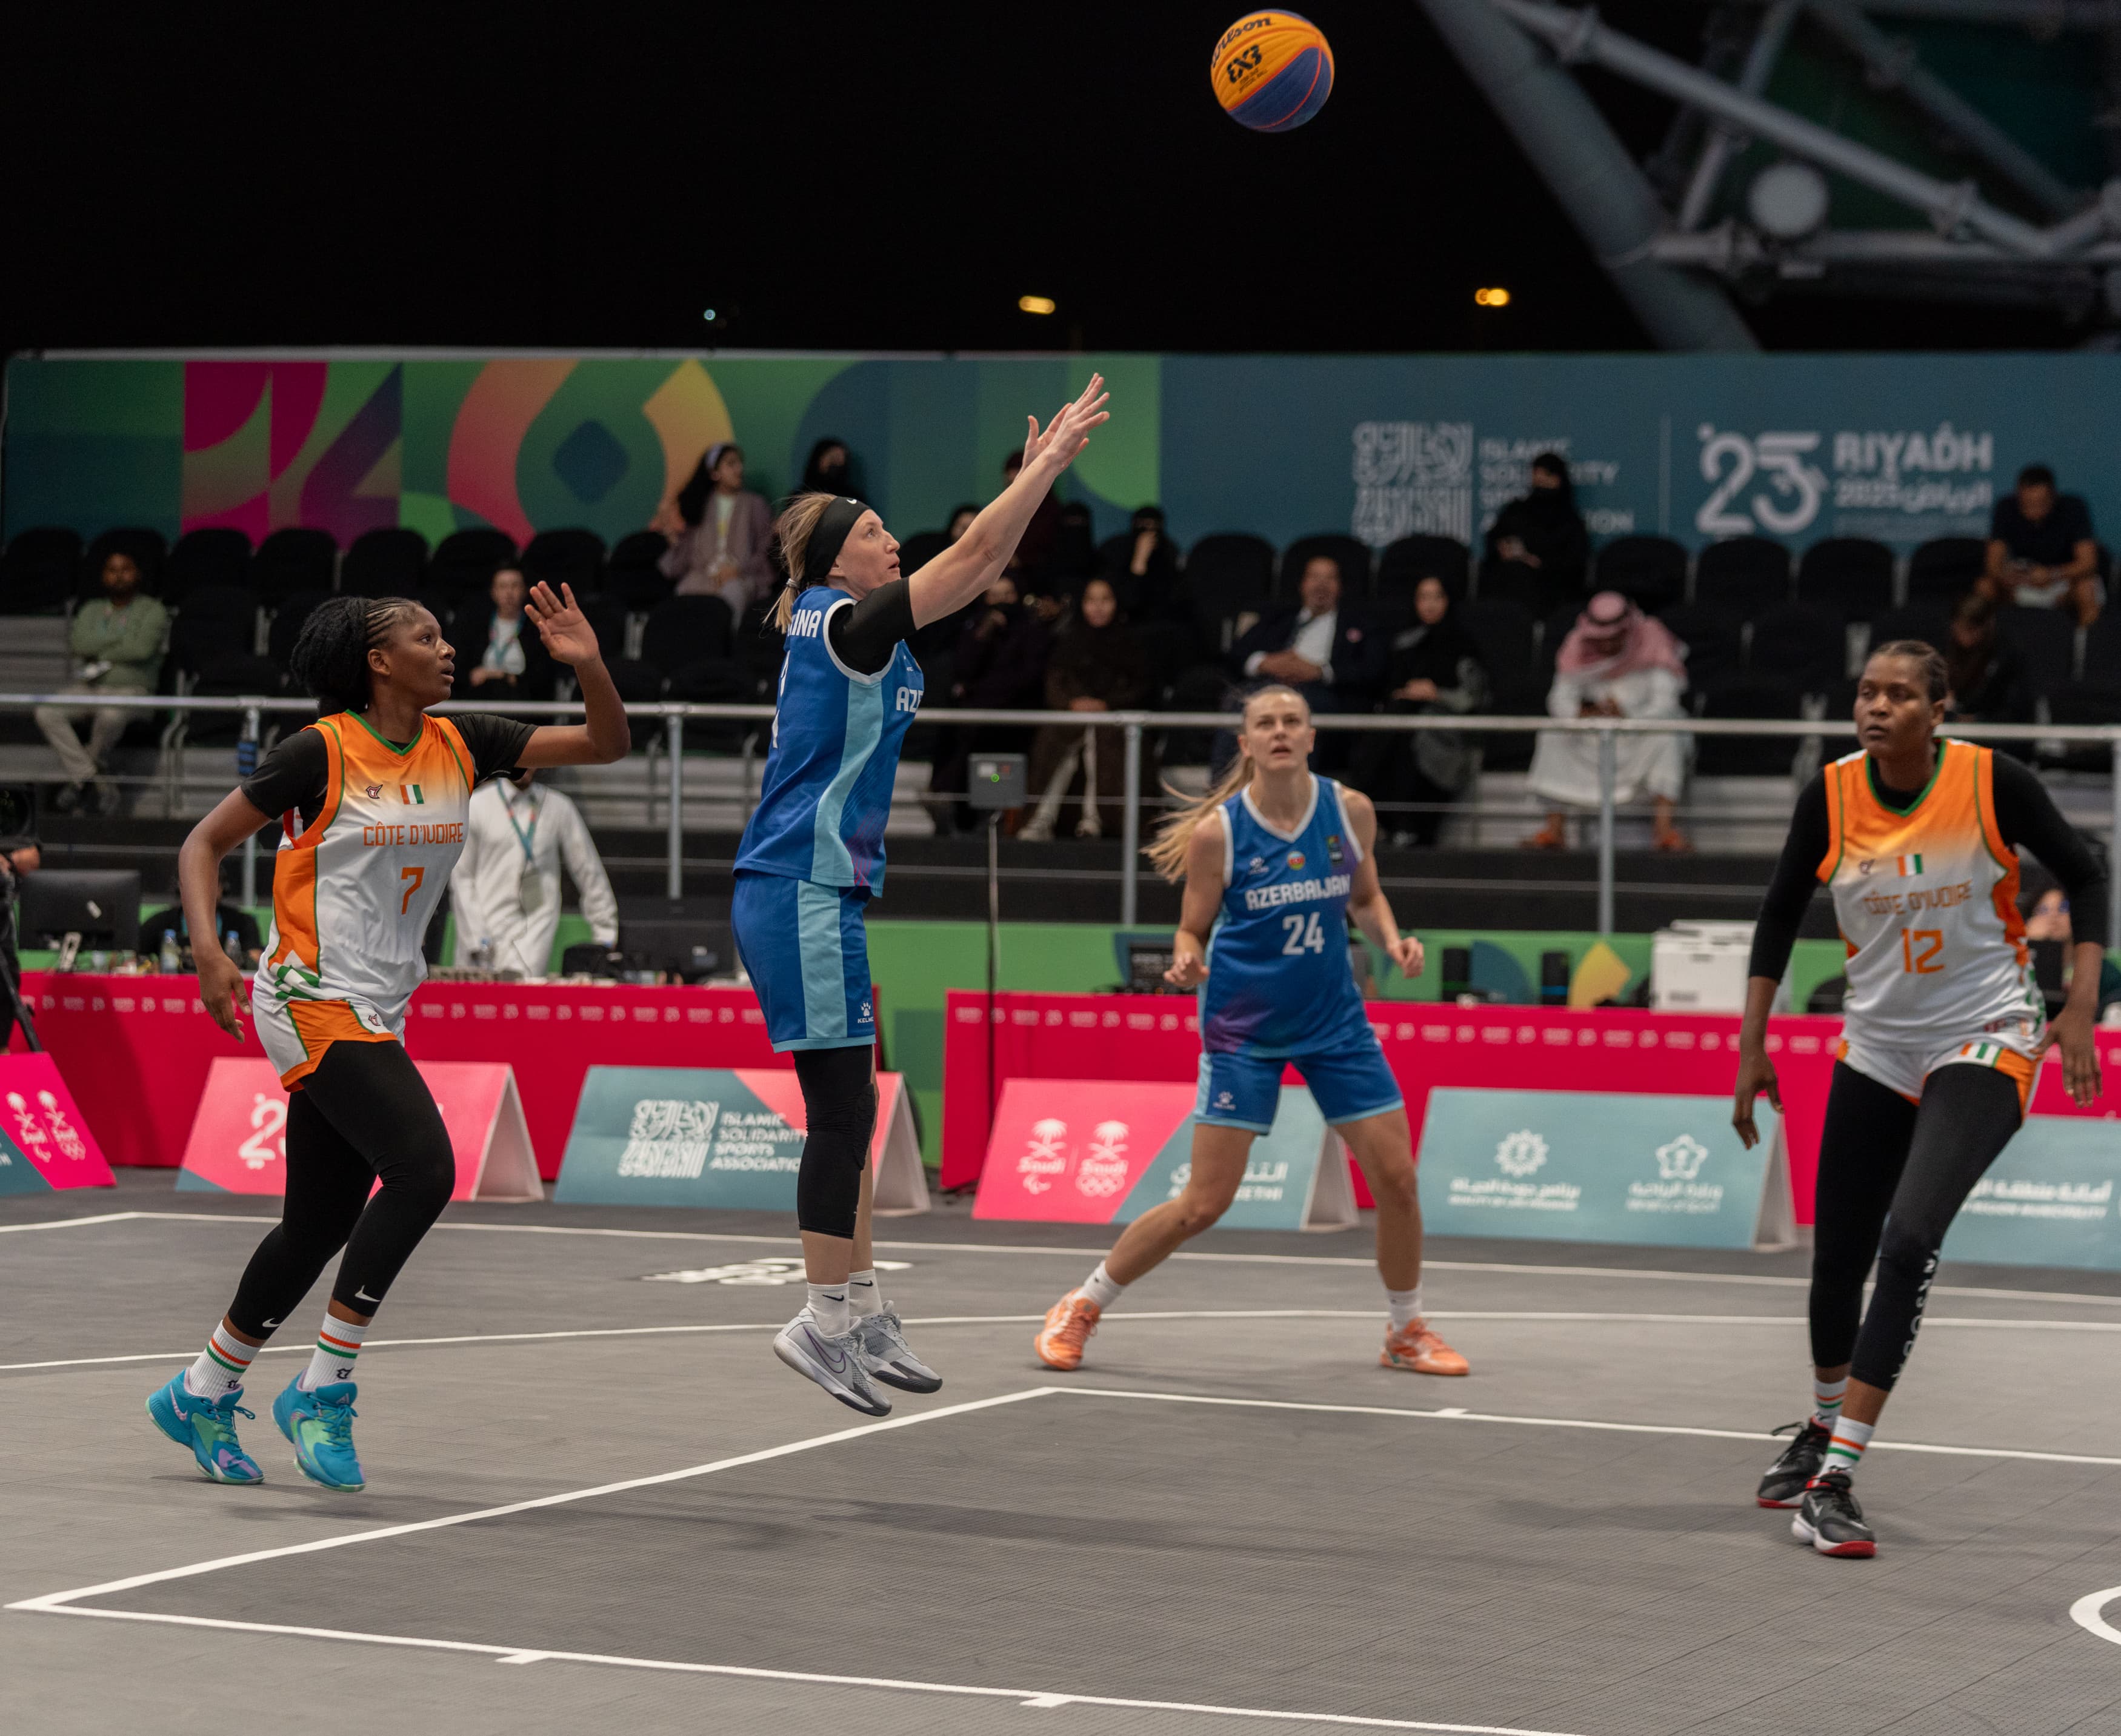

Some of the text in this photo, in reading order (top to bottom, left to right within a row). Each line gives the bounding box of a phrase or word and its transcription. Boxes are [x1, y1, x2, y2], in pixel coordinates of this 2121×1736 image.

[1833, 423, 1993, 482] RIYADH
[788, 609, 822, 637] INA
[364, 821, 405, 846] CÔTE
[401, 867, 425, 915] 7
[1245, 874, 1350, 911] AZERBAIJAN
[1282, 911, 1325, 956] 24
[1902, 928, 1945, 974] 12
[239, 1093, 287, 1169] 2
[719, 1111, 787, 1127] ISLAMIC
[709, 1155, 801, 1173] ASSOCIATIO
[714, 1142, 775, 1158] SPORTS
